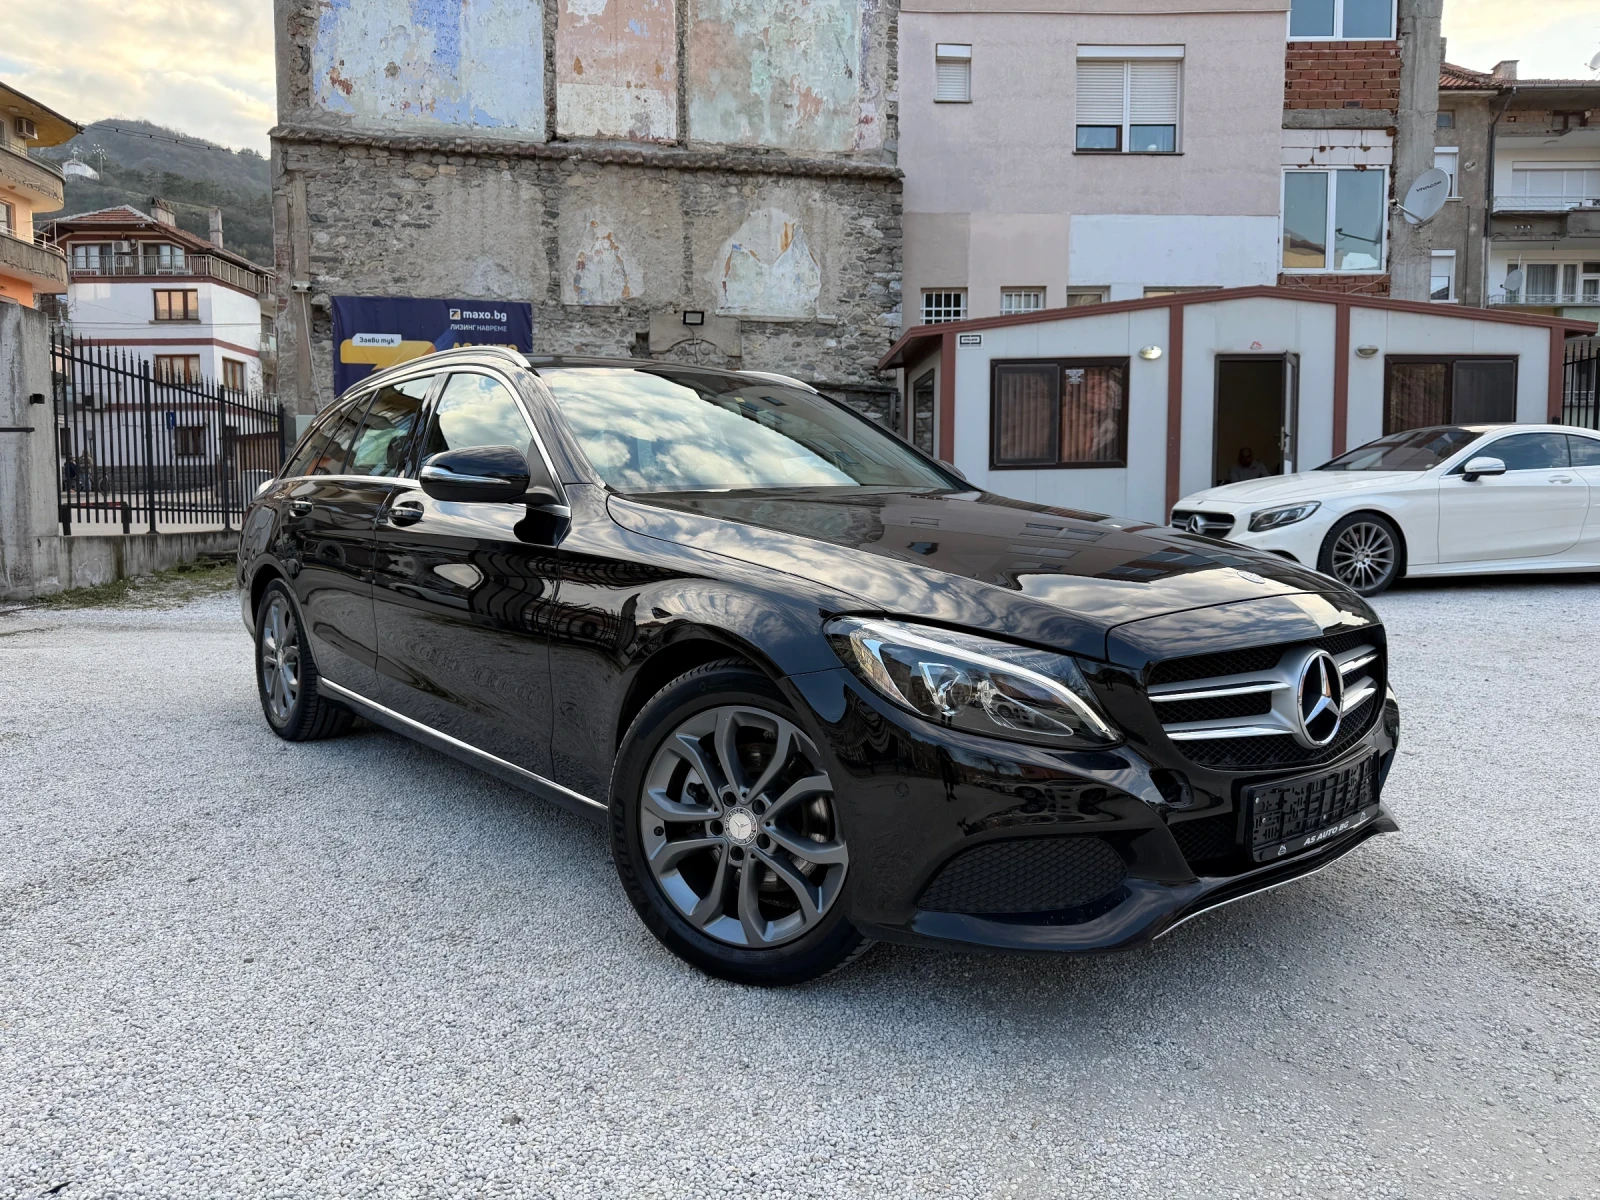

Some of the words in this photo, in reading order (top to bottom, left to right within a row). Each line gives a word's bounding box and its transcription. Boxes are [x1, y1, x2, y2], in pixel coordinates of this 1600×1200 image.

[463, 310, 507, 322] maxo.bg
[450, 323, 476, 331] ЛИЗИНГ
[1304, 835, 1317, 846] AS
[1317, 826, 1338, 841] AUTO
[1339, 820, 1350, 832] BG
